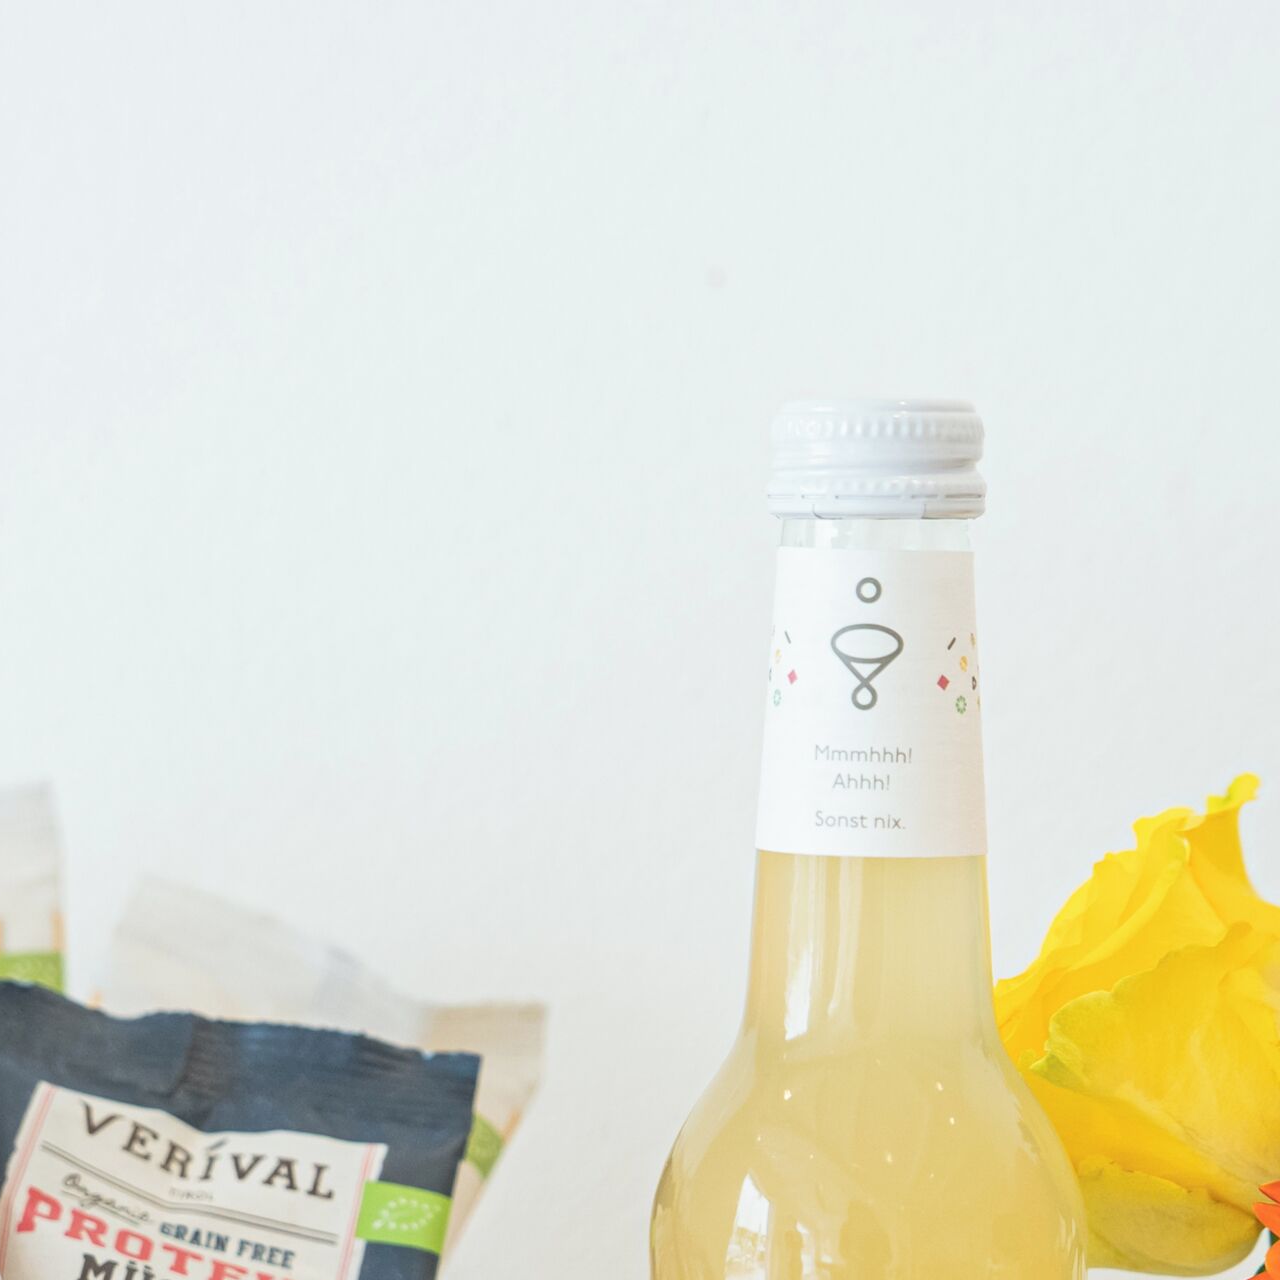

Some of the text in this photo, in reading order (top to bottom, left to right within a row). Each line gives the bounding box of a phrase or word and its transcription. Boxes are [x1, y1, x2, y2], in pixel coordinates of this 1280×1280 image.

[814, 744, 913, 764] Mmmhhh!
[832, 773, 891, 791] Ahhh!
[815, 810, 907, 830] Sonst nix.
[79, 1100, 337, 1202] VERÍVAL
[160, 1220, 229, 1253] GRAIN
[236, 1238, 297, 1270] FREE
